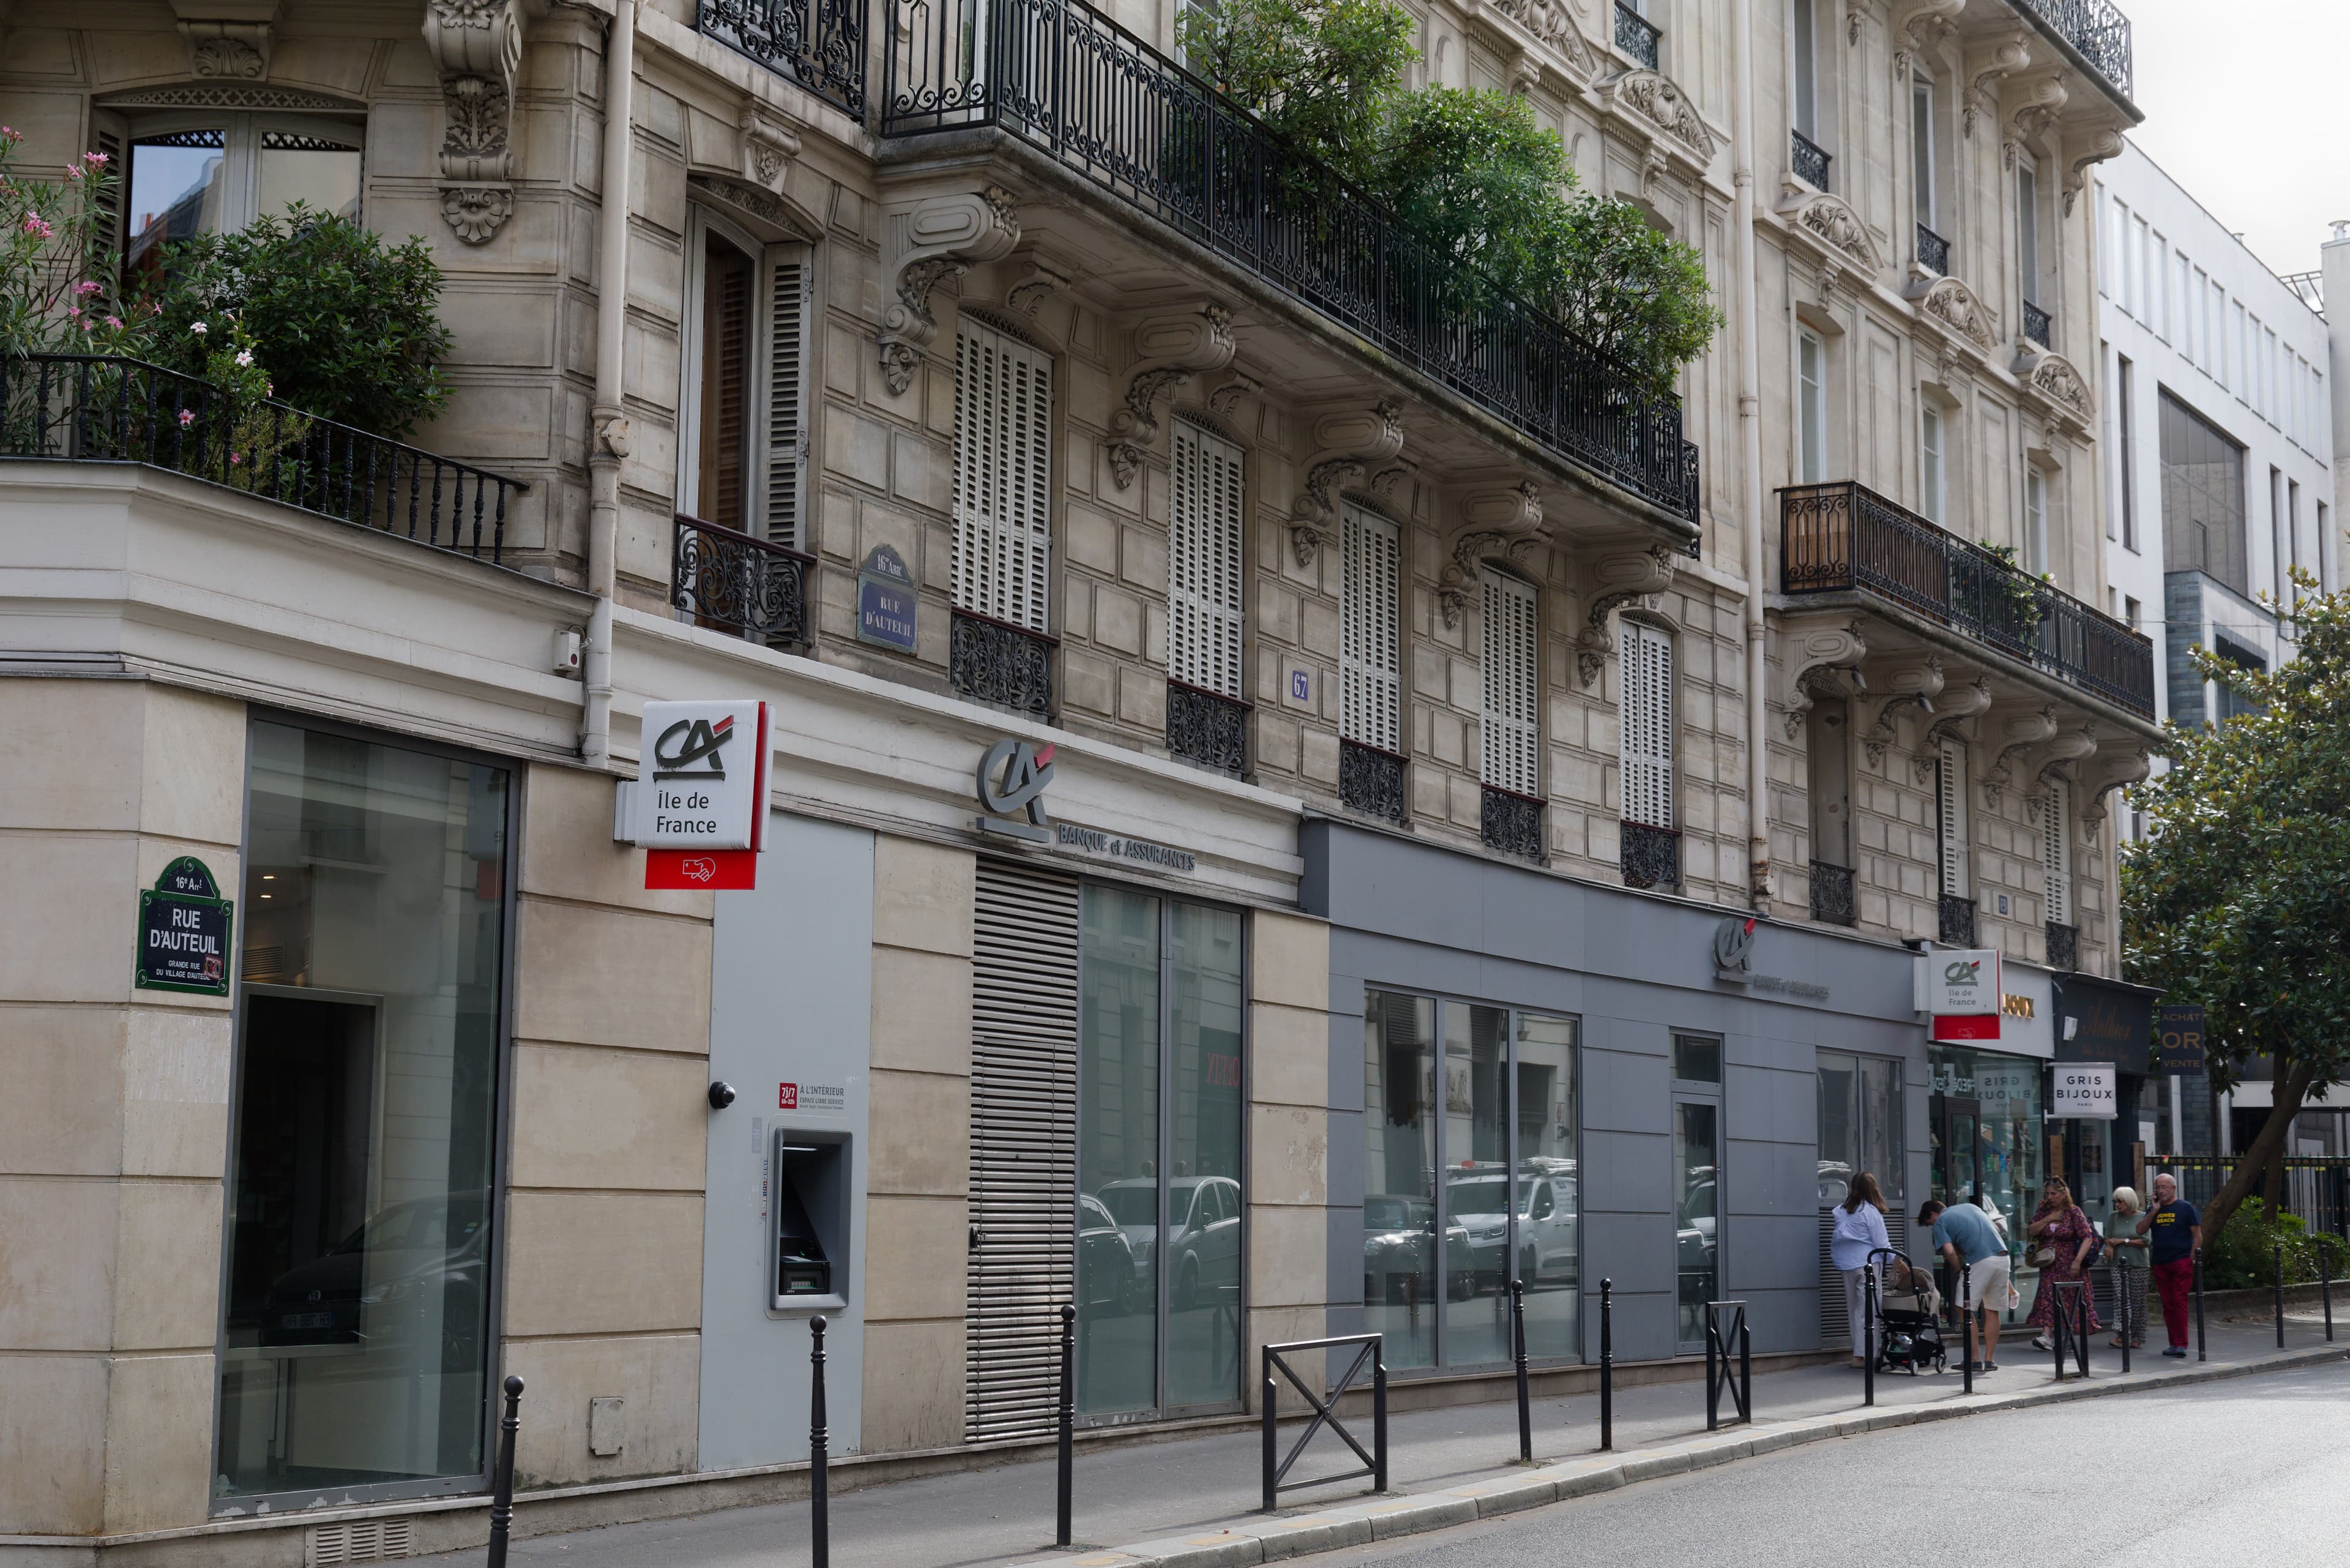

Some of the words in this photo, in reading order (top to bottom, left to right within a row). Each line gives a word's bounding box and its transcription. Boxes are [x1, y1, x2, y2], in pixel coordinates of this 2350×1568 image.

[881, 597, 900, 614] RUE
[866, 611, 912, 637] D'AUTEUIL
[1294, 674, 1307, 697] 67
[687, 792, 709, 808] de
[656, 816, 717, 833] France
[1059, 824, 1108, 853] BANQUE
[1111, 839, 1122, 855] et
[1125, 840, 1196, 872] ASSURANCES
[173, 908, 201, 929] RUE
[150, 929, 219, 954] D'AUTEUIL
[168, 960, 188, 969] GRANDE
[165, 969, 185, 978] VILLAGE
[2162, 1013, 2201, 1021] ACHAT
[2162, 1031, 2201, 1049] OR
[2067, 1076, 2101, 1085] GRIS
[781, 1087, 795, 1099] 7j/7
[806, 1084, 844, 1096] L'INTÉRIEUR
[2056, 1089, 2112, 1099] BIJOUX
